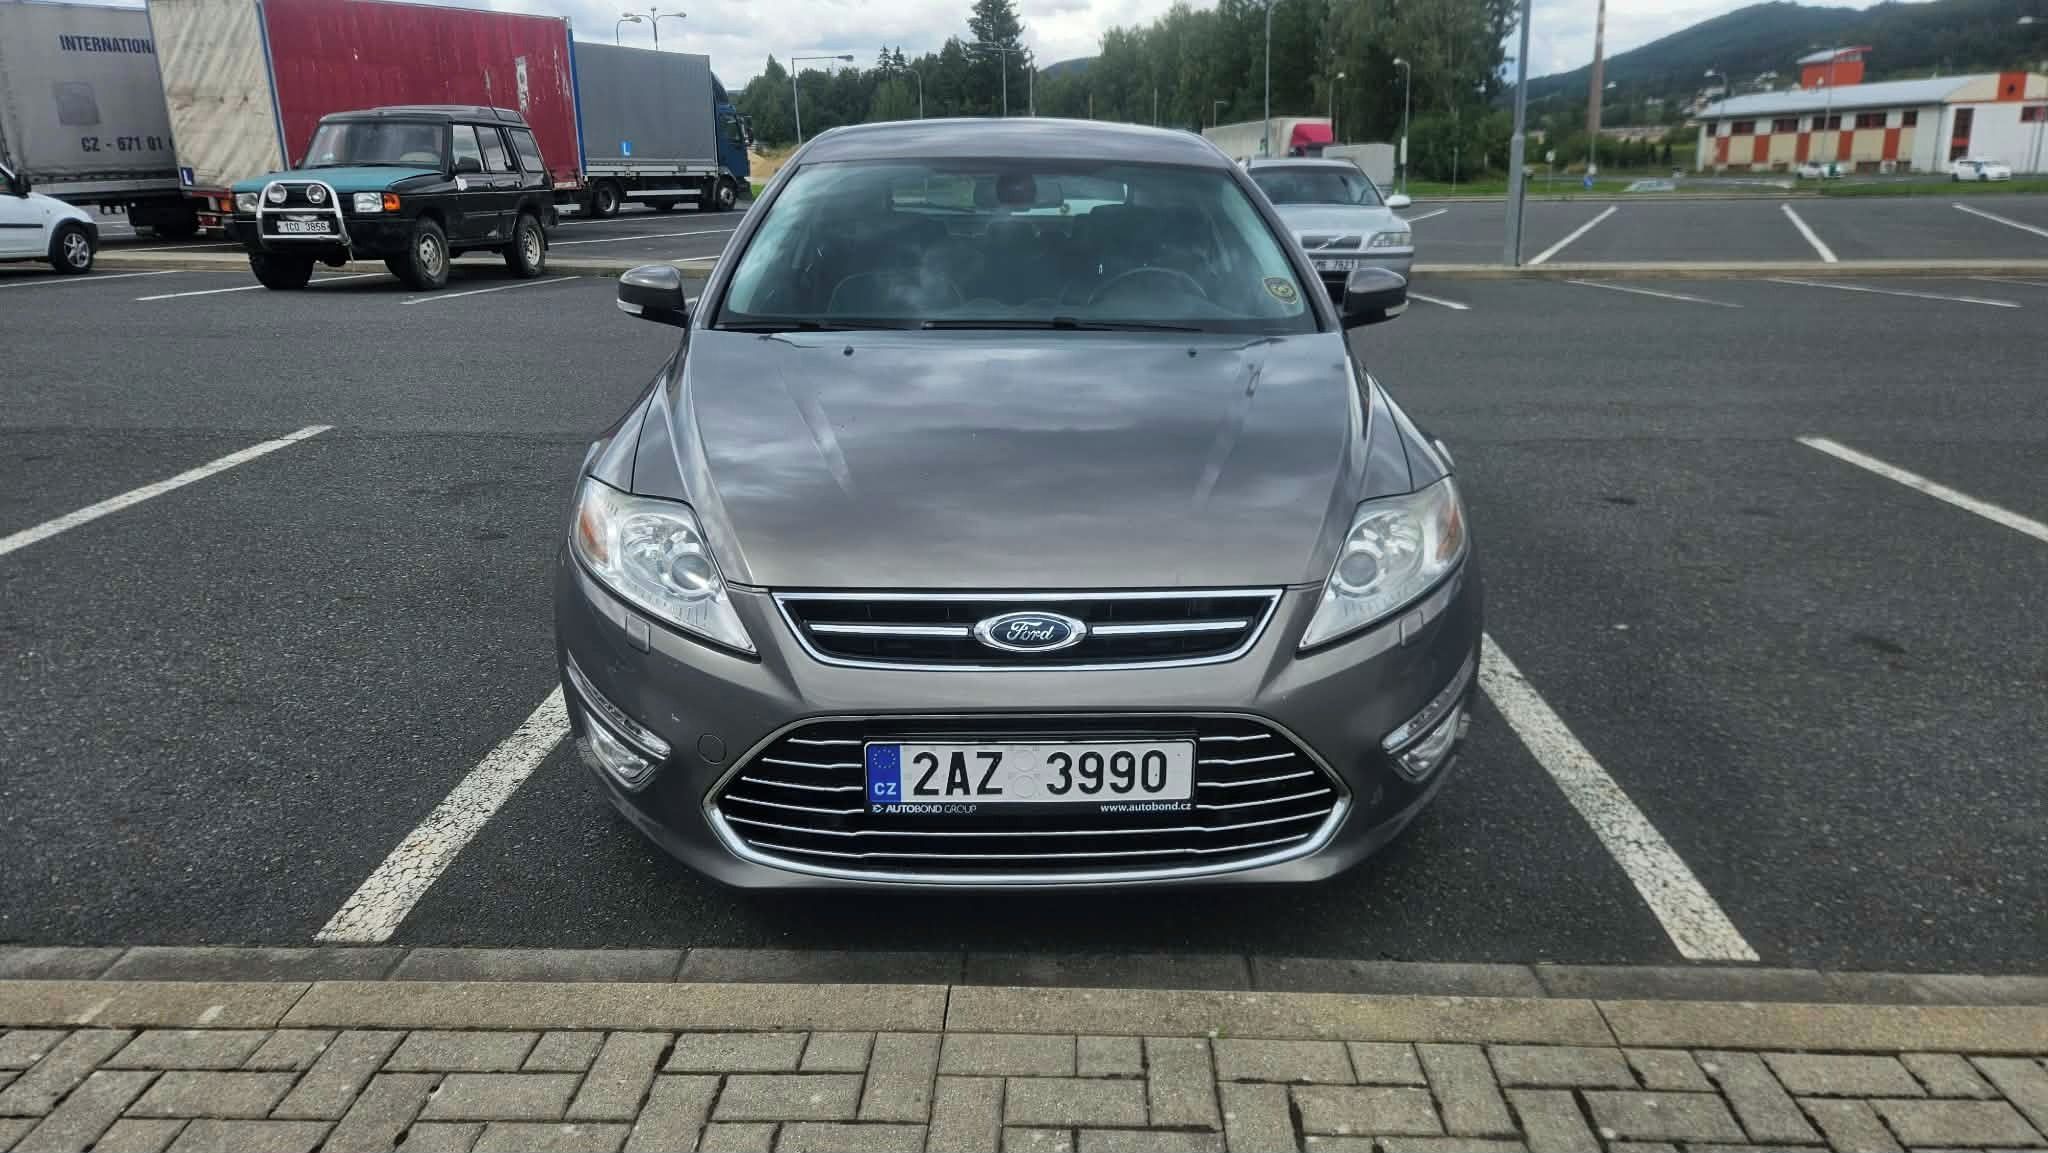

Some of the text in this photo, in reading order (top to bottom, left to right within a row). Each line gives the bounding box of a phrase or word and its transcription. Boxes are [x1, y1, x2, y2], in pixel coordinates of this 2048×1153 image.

[81, 136, 100, 152] CZ
[1006, 621, 1054, 641] Ford
[912, 750, 1167, 796] 2AZ 3990
[874, 782, 897, 796] CZ
[885, 804, 977, 813] AUTOBOND GROUP
[1100, 802, 1192, 813] www.autobond.cz
